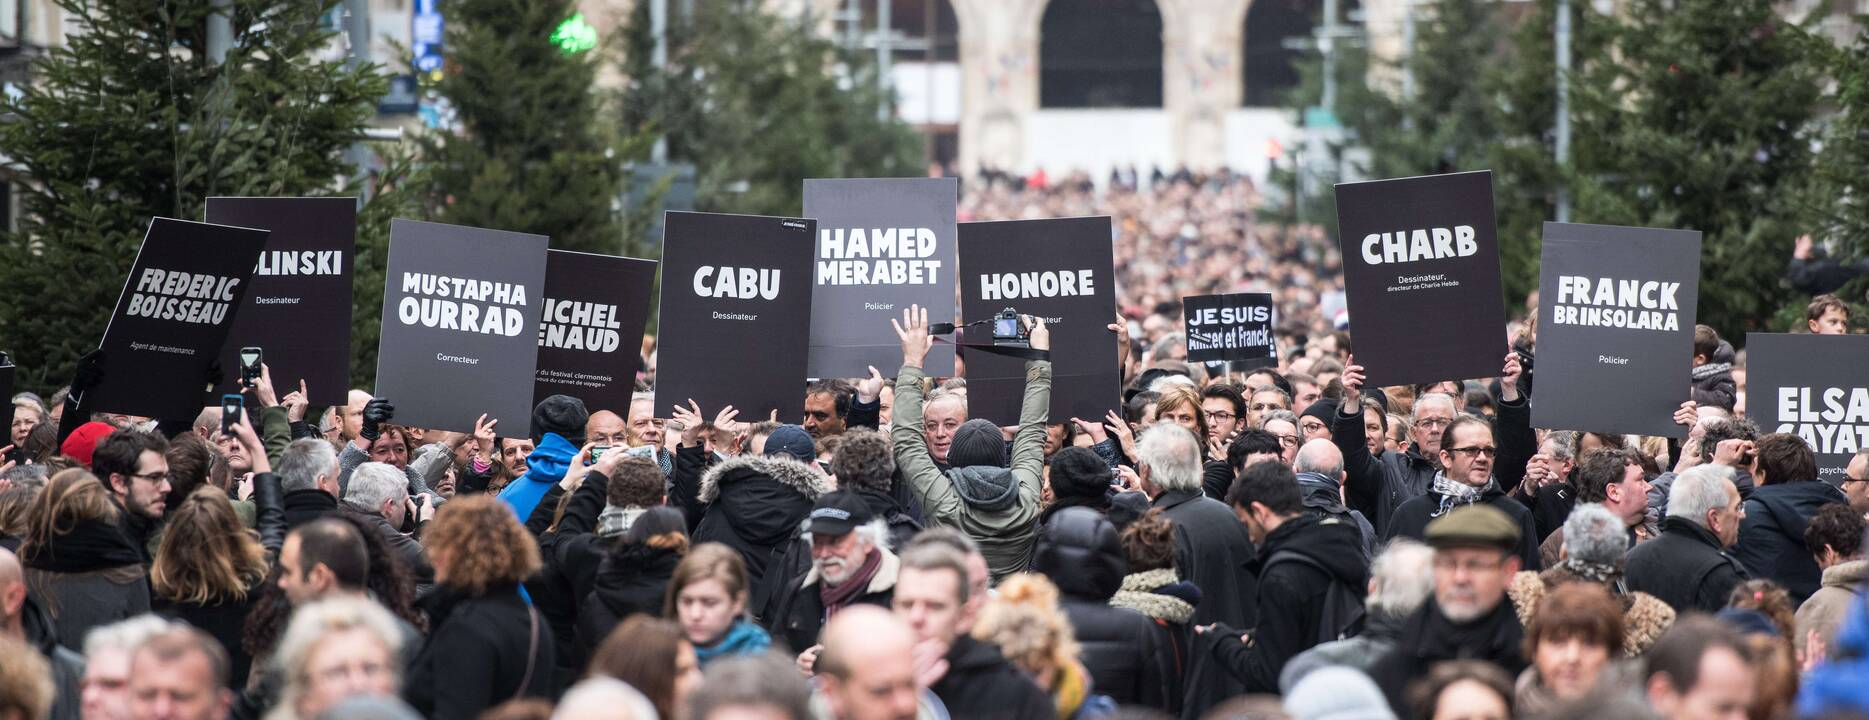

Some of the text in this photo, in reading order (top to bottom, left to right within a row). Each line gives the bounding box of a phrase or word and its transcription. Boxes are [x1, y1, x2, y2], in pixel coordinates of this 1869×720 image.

[820, 228, 937, 259] HAMED
[1361, 225, 1478, 265] CHARB
[253, 251, 342, 275] LINSKI
[817, 260, 942, 285] MERABET
[136, 267, 241, 302] FREDERIC
[402, 271, 527, 306] MUSTAPHA
[693, 265, 781, 301] CABU
[980, 269, 1095, 301] HONORE
[1387, 284, 1412, 292] directeur
[1421, 281, 1440, 289] Charlie
[1557, 275, 1681, 310] FRANCK
[126, 293, 230, 326] BOISSEAU
[256, 296, 301, 305] Dessinateur
[865, 302, 894, 311] Policier
[398, 296, 524, 337] OURRAD
[541, 298, 621, 330] ICHEL
[712, 311, 758, 321] Dessinateur
[1188, 306, 1269, 326] JE SUIS
[1553, 305, 1679, 332] BRINSOLARA
[129, 341, 196, 356] Agent de maintenance
[1225, 327, 1237, 349] et
[1238, 324, 1269, 348] Franck
[437, 353, 480, 365] Correcteur
[1598, 355, 1630, 365] Policier
[550, 370, 573, 379] festival
[574, 373, 613, 382] clermontois
[1778, 387, 1869, 423] ELSA
